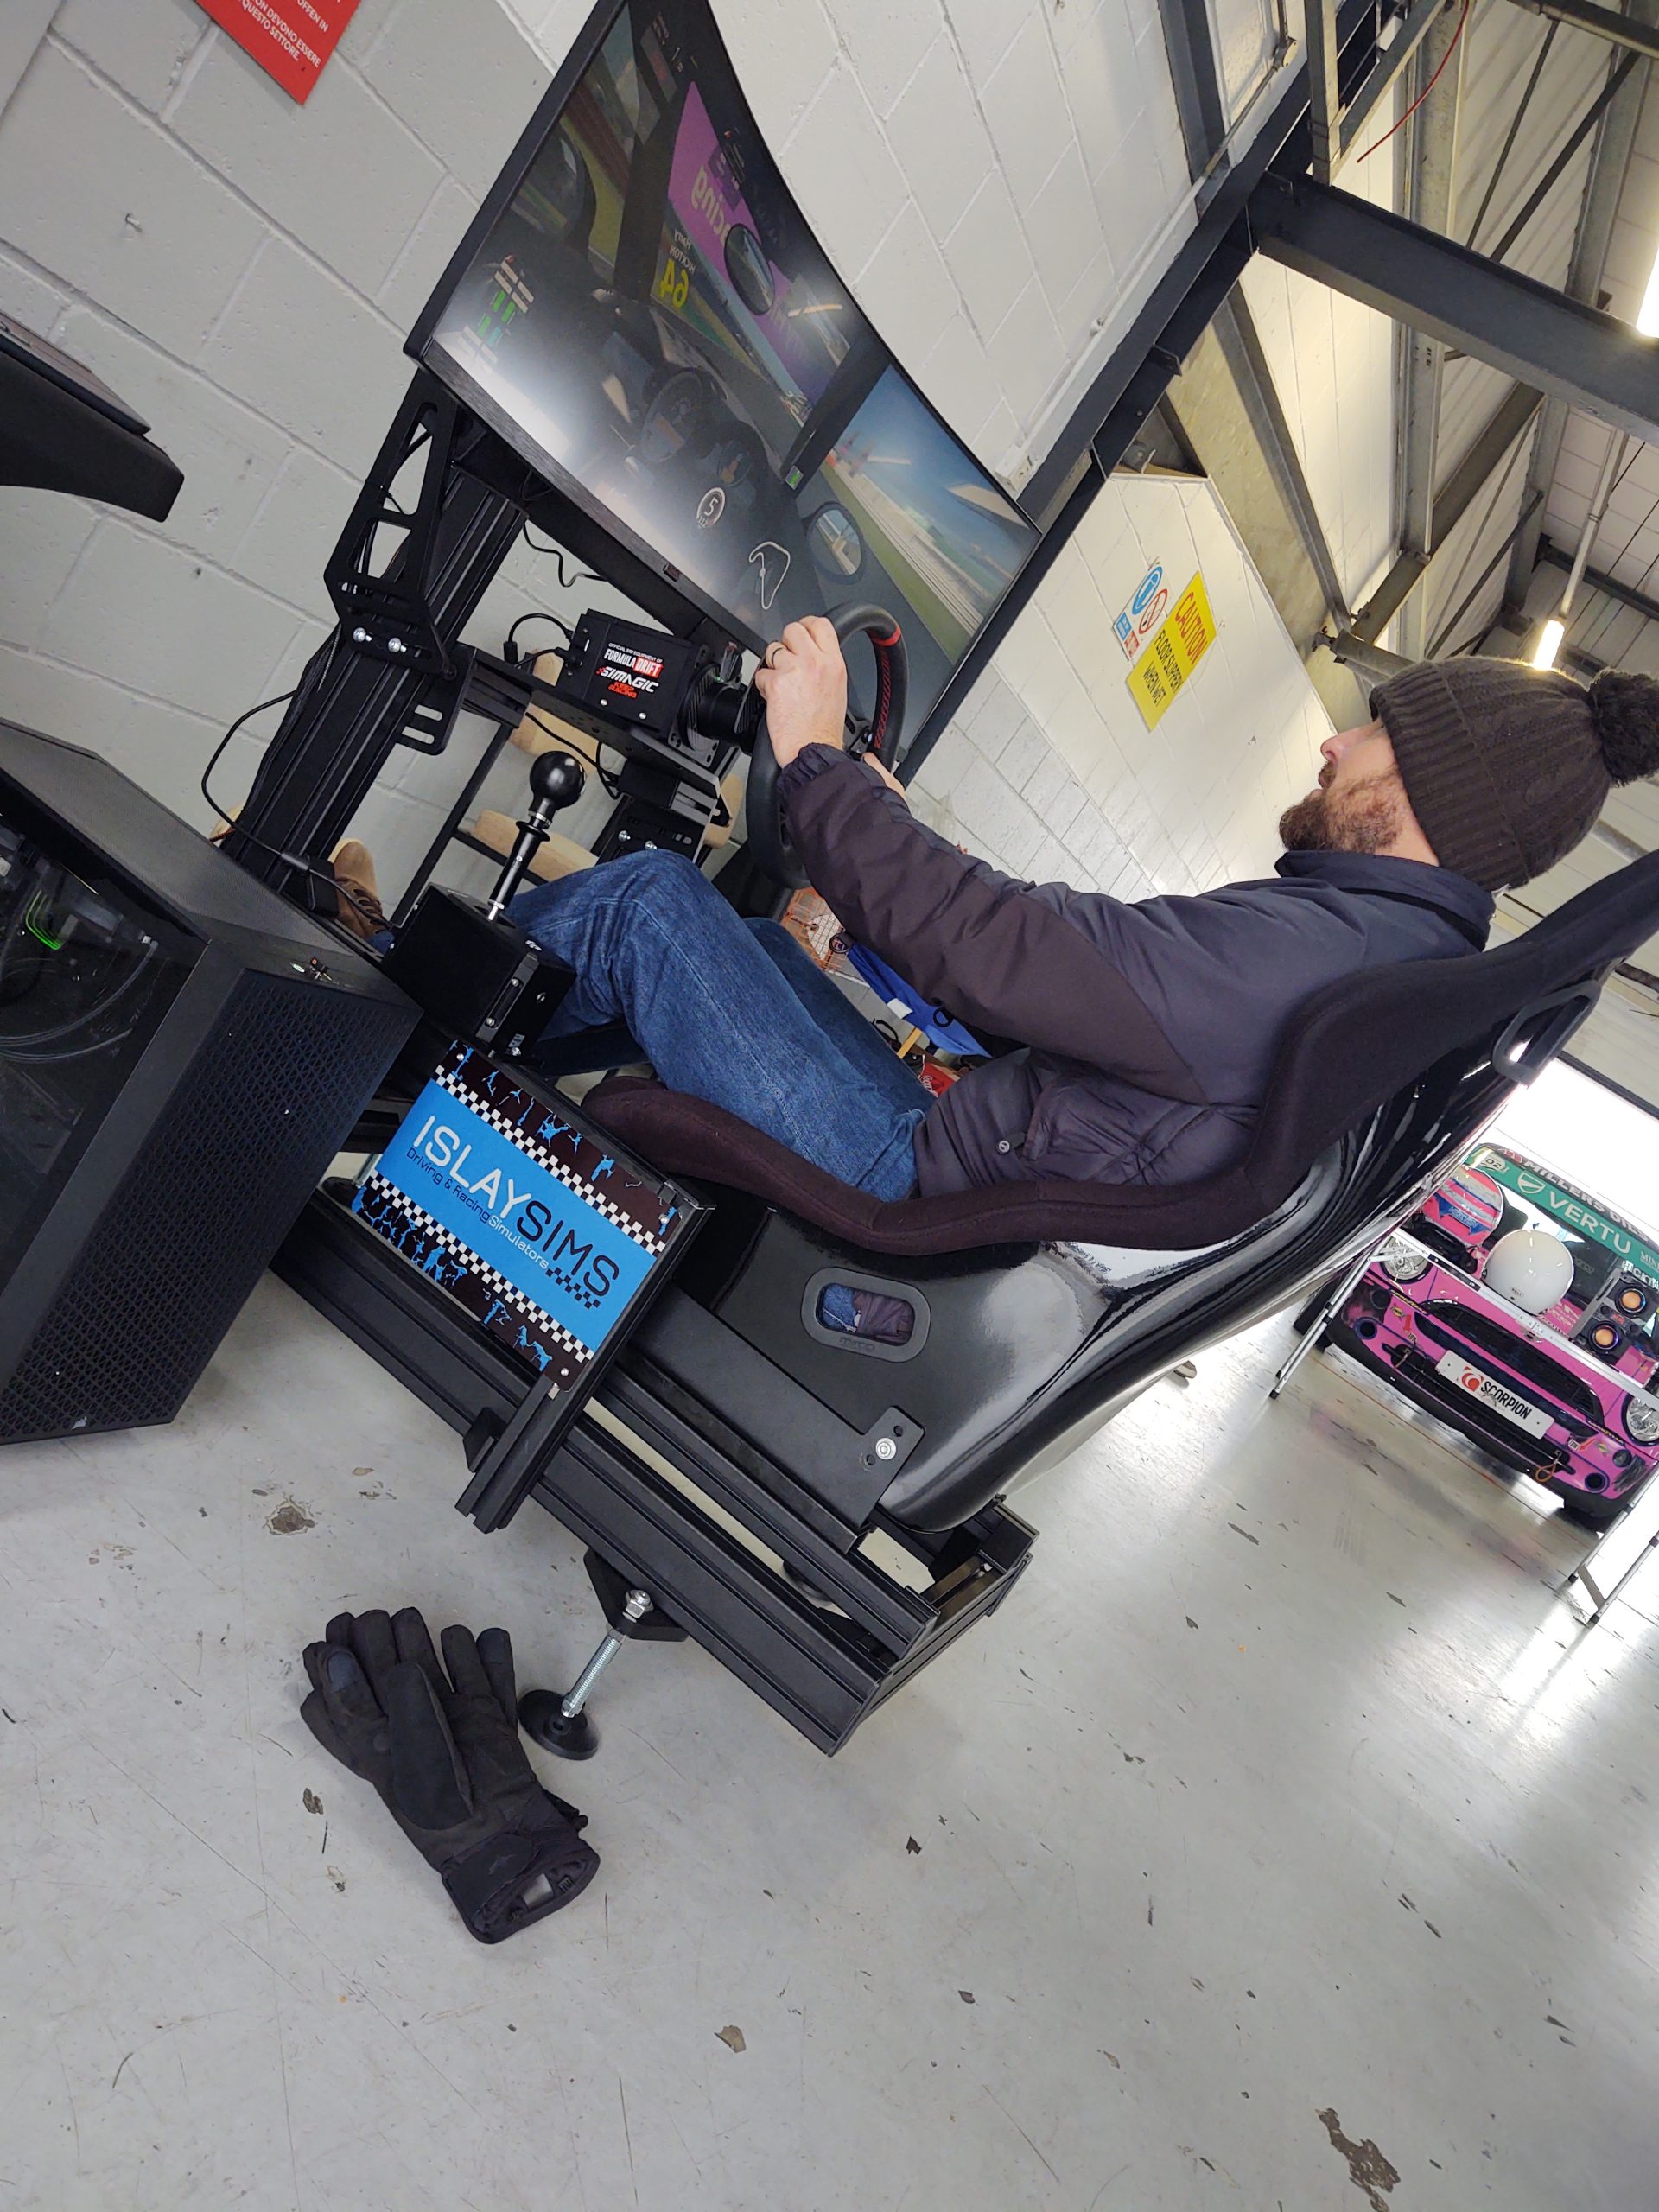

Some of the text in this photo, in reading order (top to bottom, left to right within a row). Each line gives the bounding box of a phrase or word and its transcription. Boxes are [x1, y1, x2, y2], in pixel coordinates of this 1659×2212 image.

[242, 0, 270, 29] QUESTO
[318, 19, 328, 32] IN
[266, 8, 297, 42] DEVONO
[296, 39, 321, 67] ESSERE
[703, 497, 719, 516] 5
[1174, 592, 1208, 665] CAUTION
[604, 648, 662, 677] FORMULA DRIFT
[1154, 629, 1173, 665] FLOOR
[600, 665, 659, 693] SIMAGIC
[1143, 661, 1161, 694] WHEN
[406, 1147, 443, 1185] Driving
[444, 1179, 452, 1190] &
[1524, 1160, 1649, 1243] MILLERS OILS
[1550, 1191, 1631, 1254] VERTU
[1481, 1381, 1532, 1420] SCORPION
